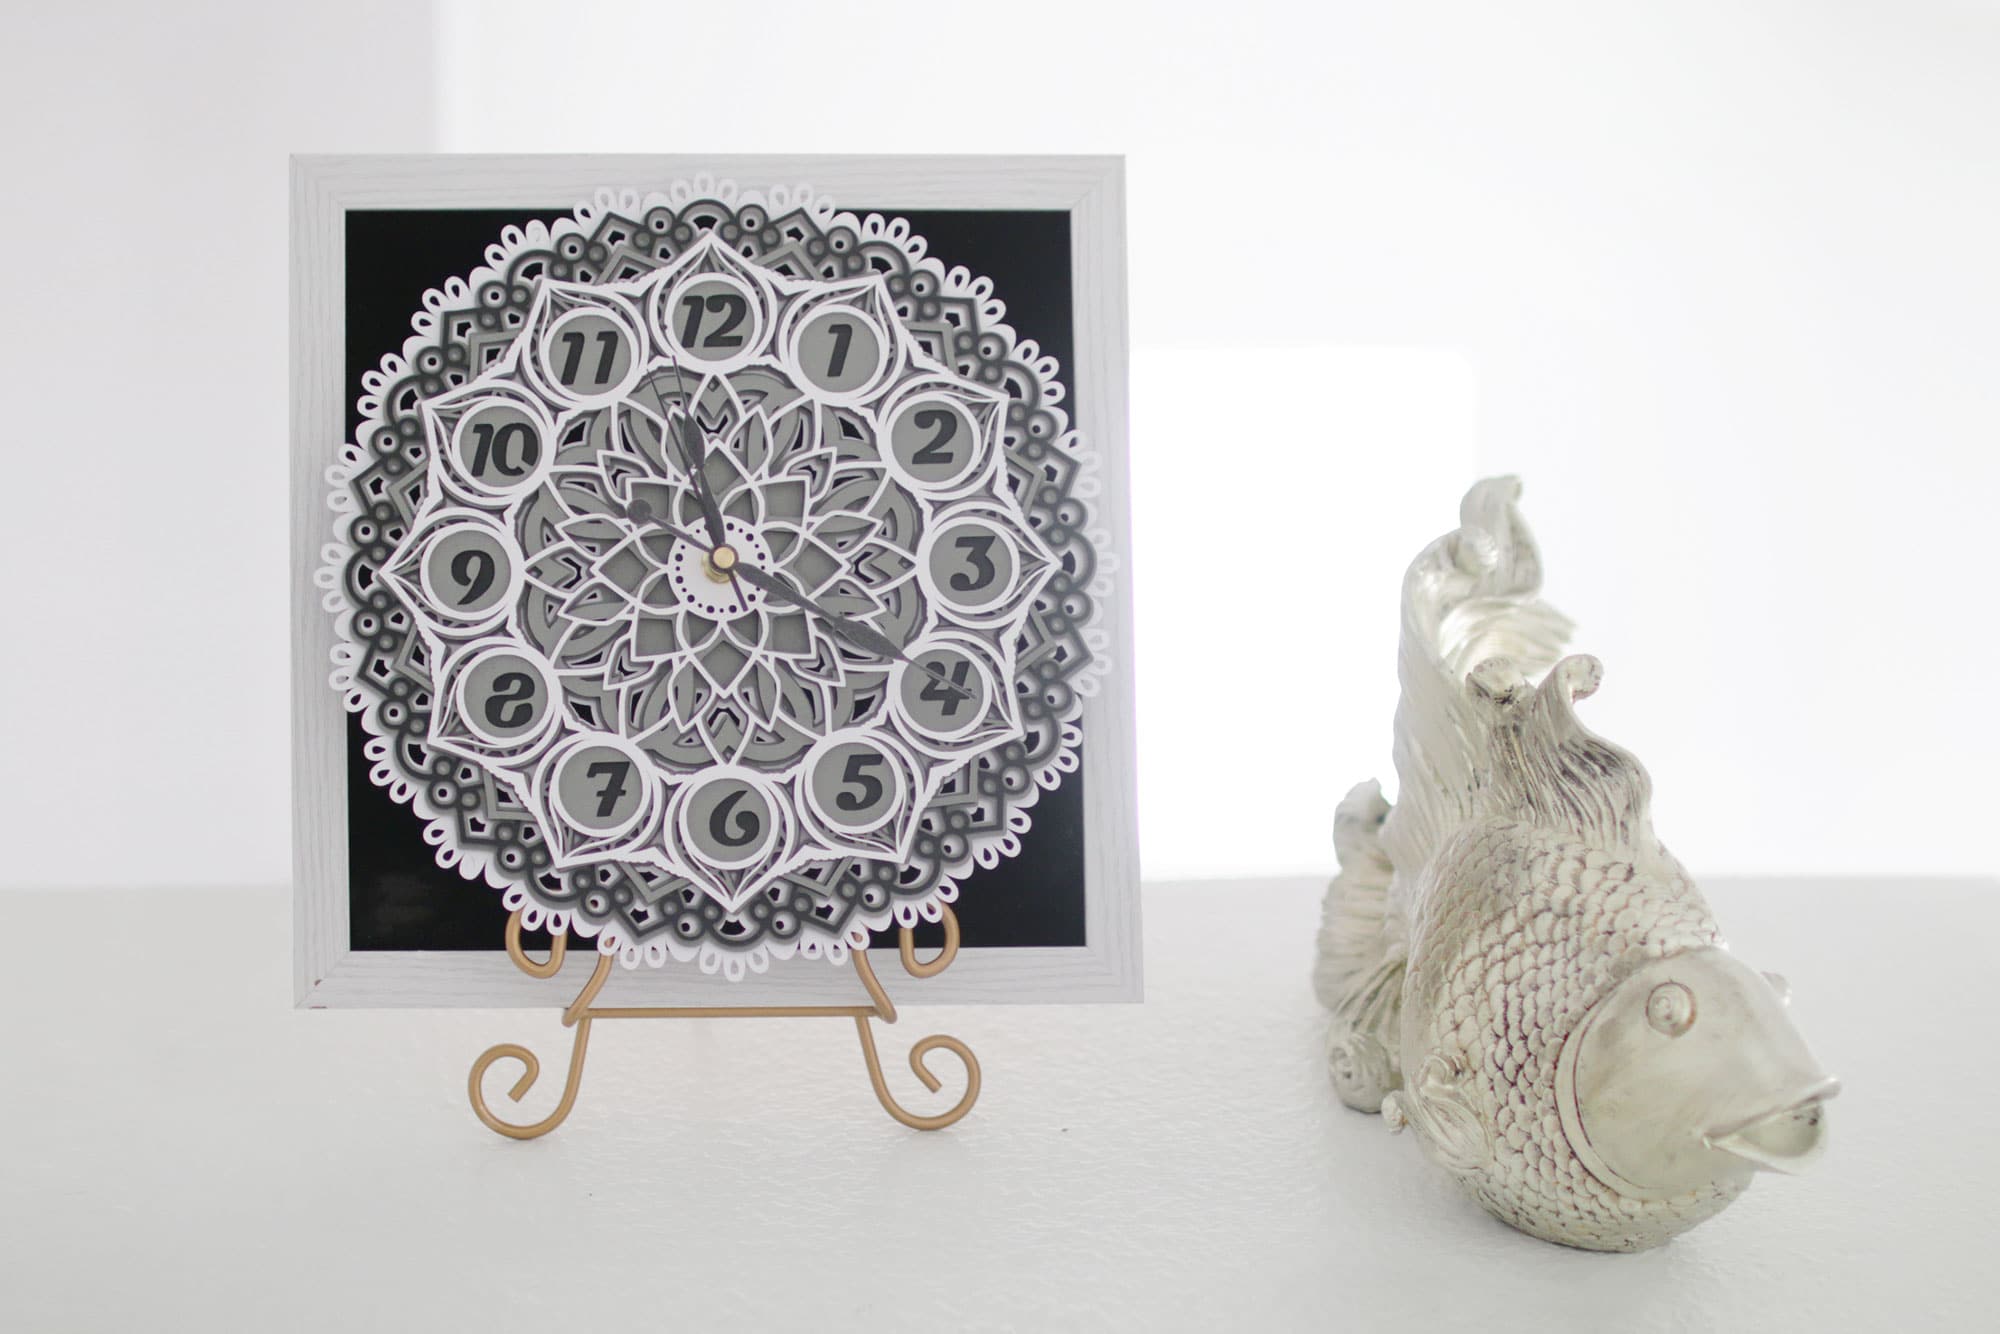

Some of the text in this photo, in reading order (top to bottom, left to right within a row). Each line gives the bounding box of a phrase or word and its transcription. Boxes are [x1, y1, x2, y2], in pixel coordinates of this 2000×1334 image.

[682, 294, 747, 347] 12
[561, 331, 618, 385] 11
[827, 324, 852, 377] 1
[471, 423, 539, 476] 10
[912, 409, 957, 464] 2
[451, 550, 495, 605] 9
[950, 535, 996, 591] 3
[485, 672, 535, 728] 8
[920, 660, 971, 716] 4
[586, 761, 631, 817] 7
[835, 754, 883, 811] 5
[709, 790, 760, 847] 6
